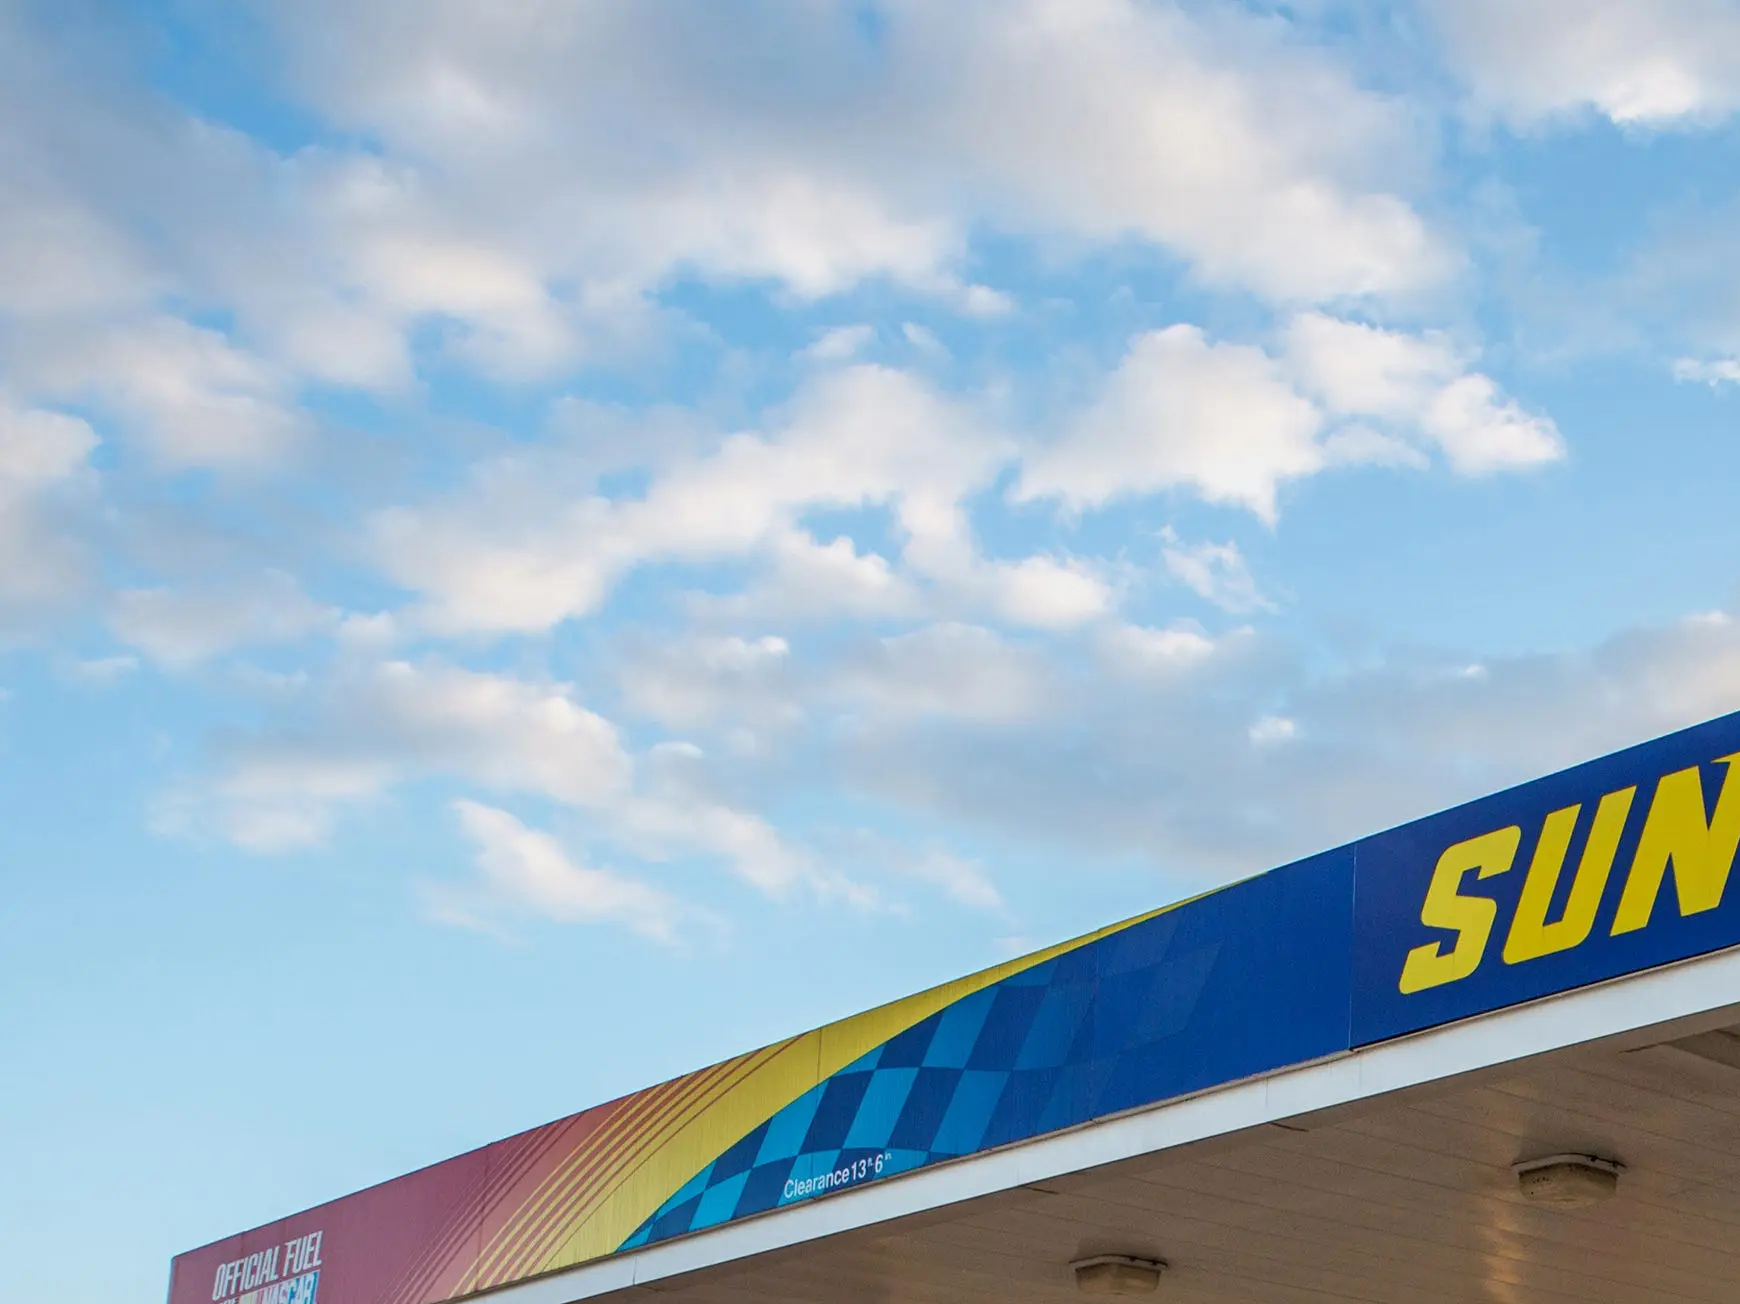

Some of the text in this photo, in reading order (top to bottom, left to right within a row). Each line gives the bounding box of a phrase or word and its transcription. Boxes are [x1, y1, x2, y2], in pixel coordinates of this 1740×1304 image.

[783, 1168, 849, 1199] Clearance
[211, 1230, 323, 1302] OFFICIAL FUEL
